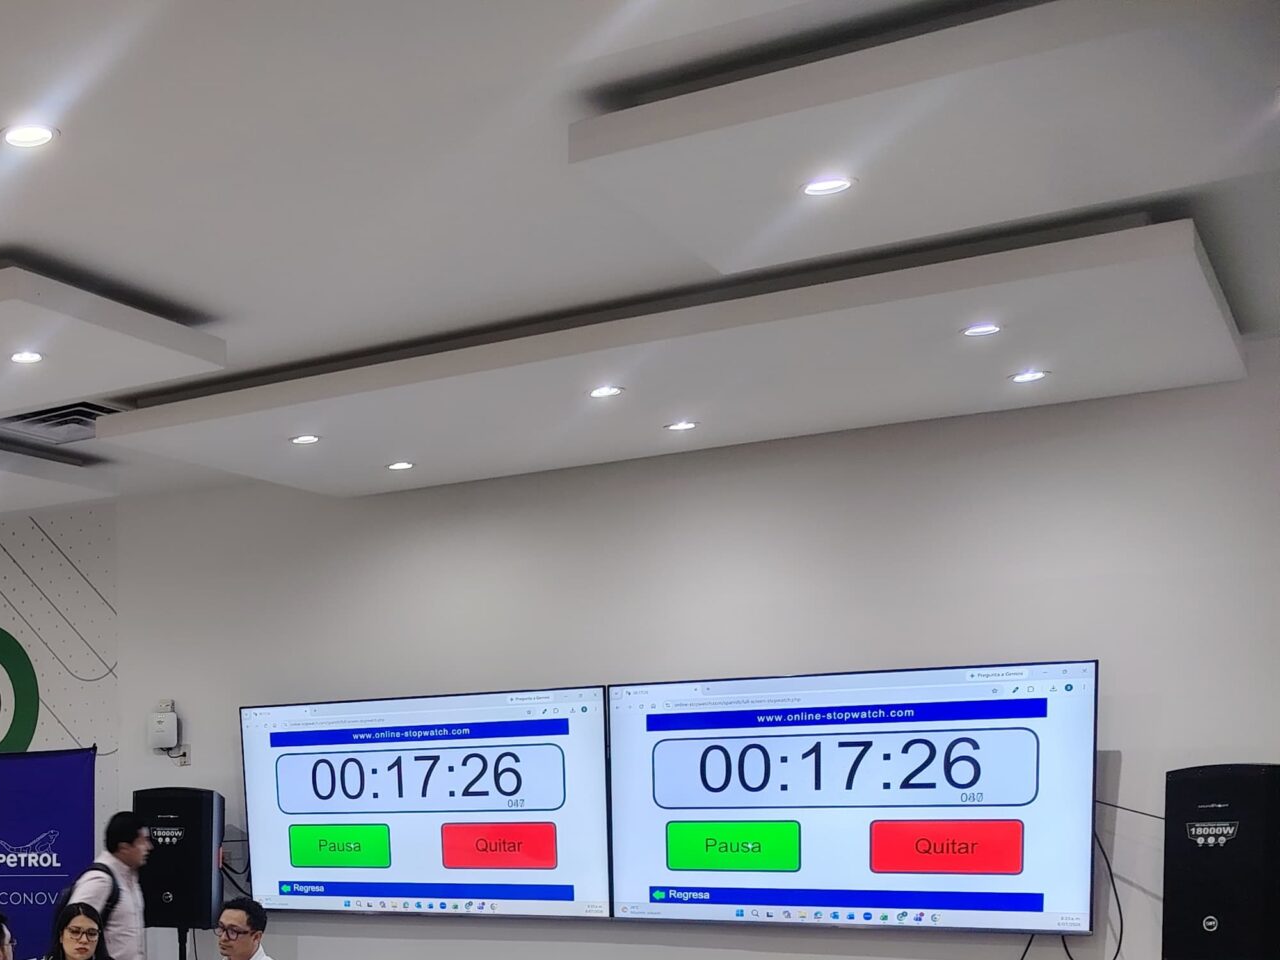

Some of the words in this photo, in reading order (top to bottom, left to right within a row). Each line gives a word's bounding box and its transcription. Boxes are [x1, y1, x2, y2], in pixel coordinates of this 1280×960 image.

[756, 707, 915, 723] www.online-stopwatch.com
[352, 726, 470, 740] www.online-stopwatch.com
[699, 737, 982, 793] 00:17:26
[311, 751, 523, 800] 00:17:26
[1190, 826, 1235, 835] 18000W
[318, 839, 362, 853] Pausa
[475, 838, 523, 855] Quitar
[705, 838, 762, 853] Pausa
[914, 837, 979, 856] Quitar
[293, 883, 325, 894] Regresa
[668, 888, 710, 901] Regresa
